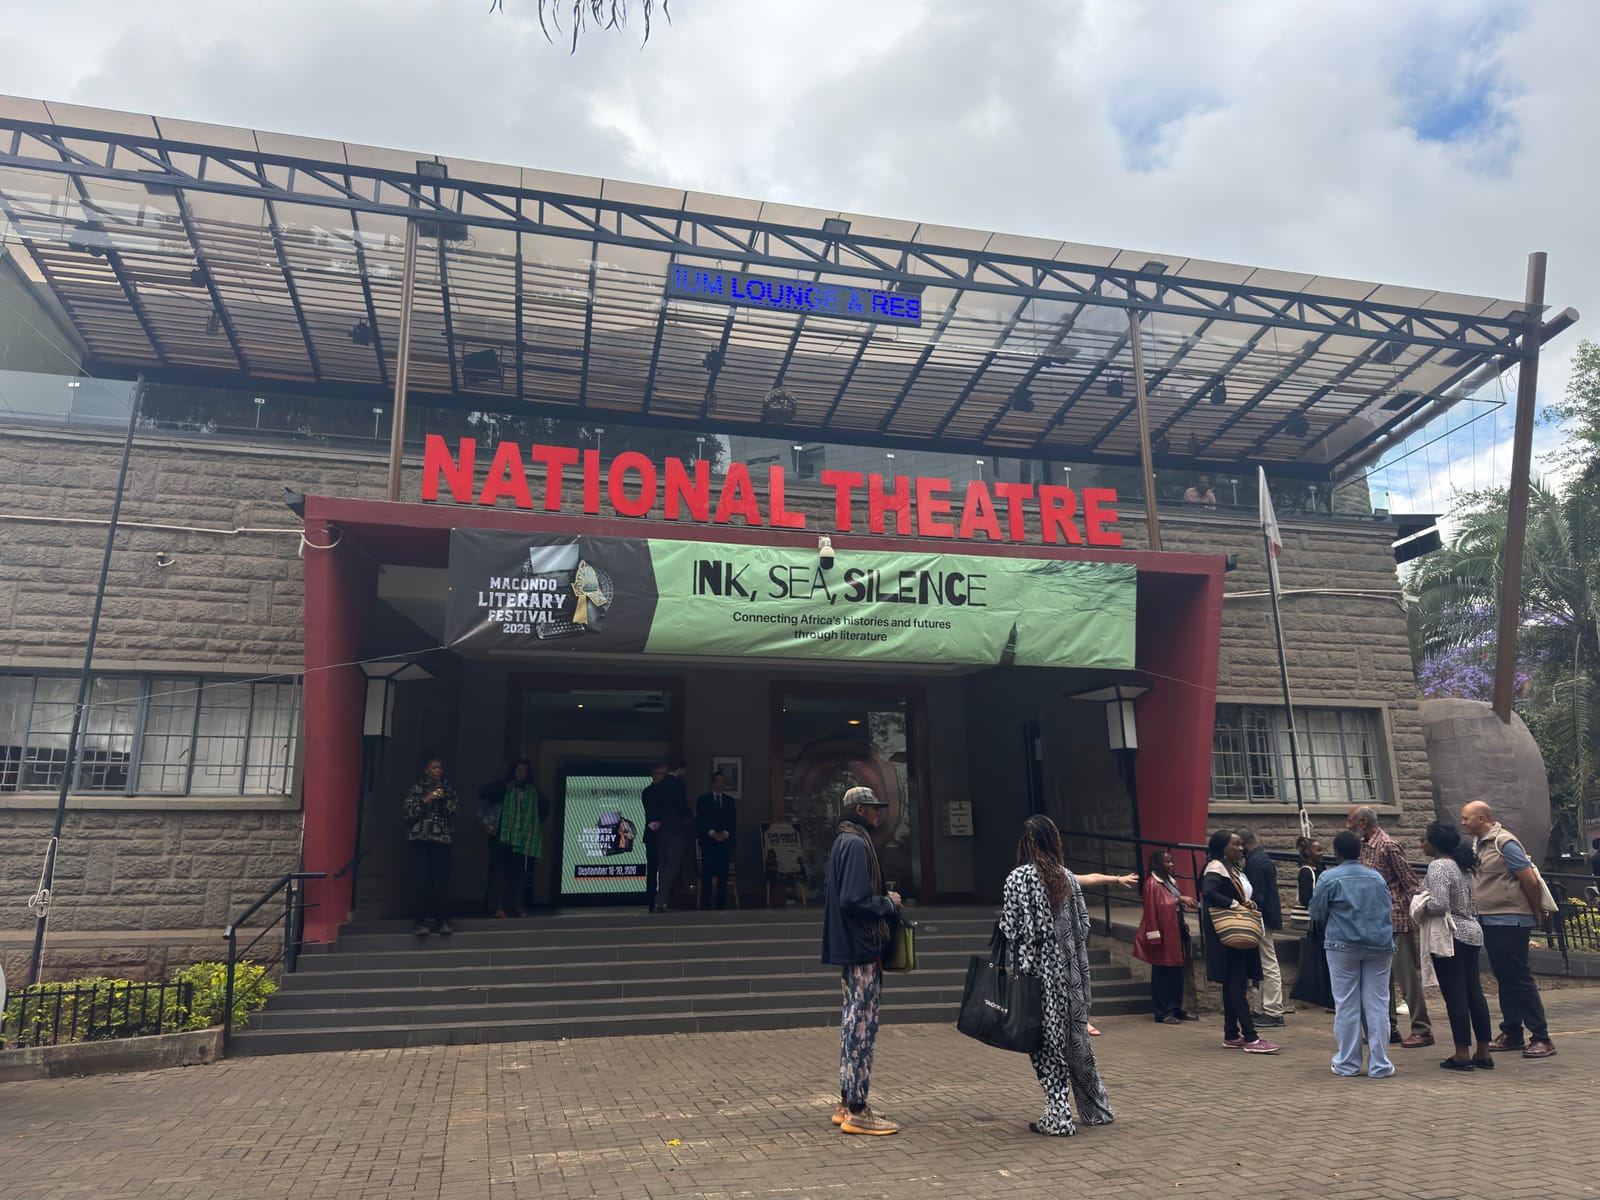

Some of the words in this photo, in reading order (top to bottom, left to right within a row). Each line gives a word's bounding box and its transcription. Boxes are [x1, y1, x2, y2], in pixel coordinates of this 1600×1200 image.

[731, 277, 840, 310] LOUNGE
[848, 291, 865, 314] &
[421, 434, 807, 528] NATIONAL
[821, 470, 1124, 548] THEATRE
[490, 576, 557, 591] MACONDO
[692, 560, 757, 601] INK,
[768, 564, 838, 605] SEA,
[843, 567, 987, 607] SILENCE
[478, 591, 567, 609] LITERARY
[487, 609, 556, 623] FESTIVAL
[732, 611, 798, 626] Connecting
[800, 614, 841, 626] Africa's
[843, 615, 889, 628] histories
[890, 617, 911, 628] and
[912, 618, 952, 630] futures
[794, 629, 837, 642] through
[839, 630, 888, 642] literature
